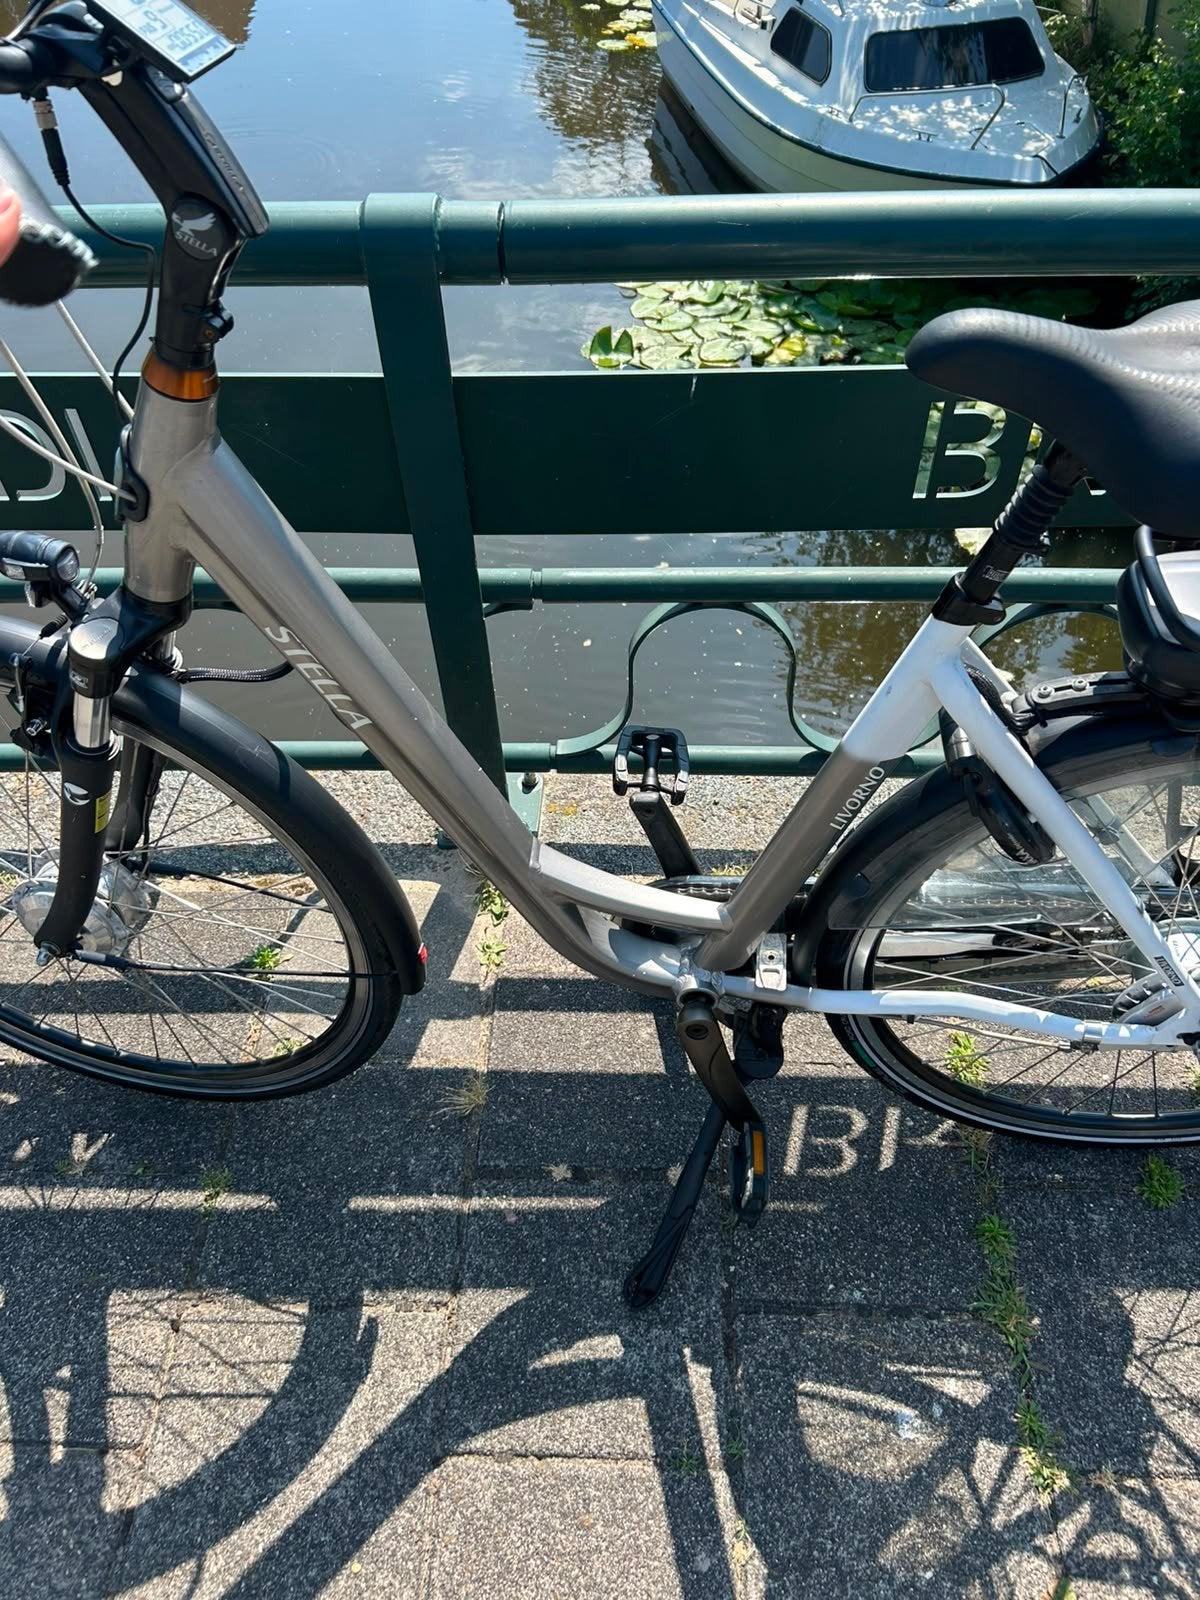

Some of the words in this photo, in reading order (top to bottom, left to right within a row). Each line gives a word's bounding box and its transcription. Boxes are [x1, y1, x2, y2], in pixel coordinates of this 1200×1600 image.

[175, 230, 218, 257] STELLA
[265, 625, 372, 731] STELLA
[829, 765, 886, 832] LIVORNO
